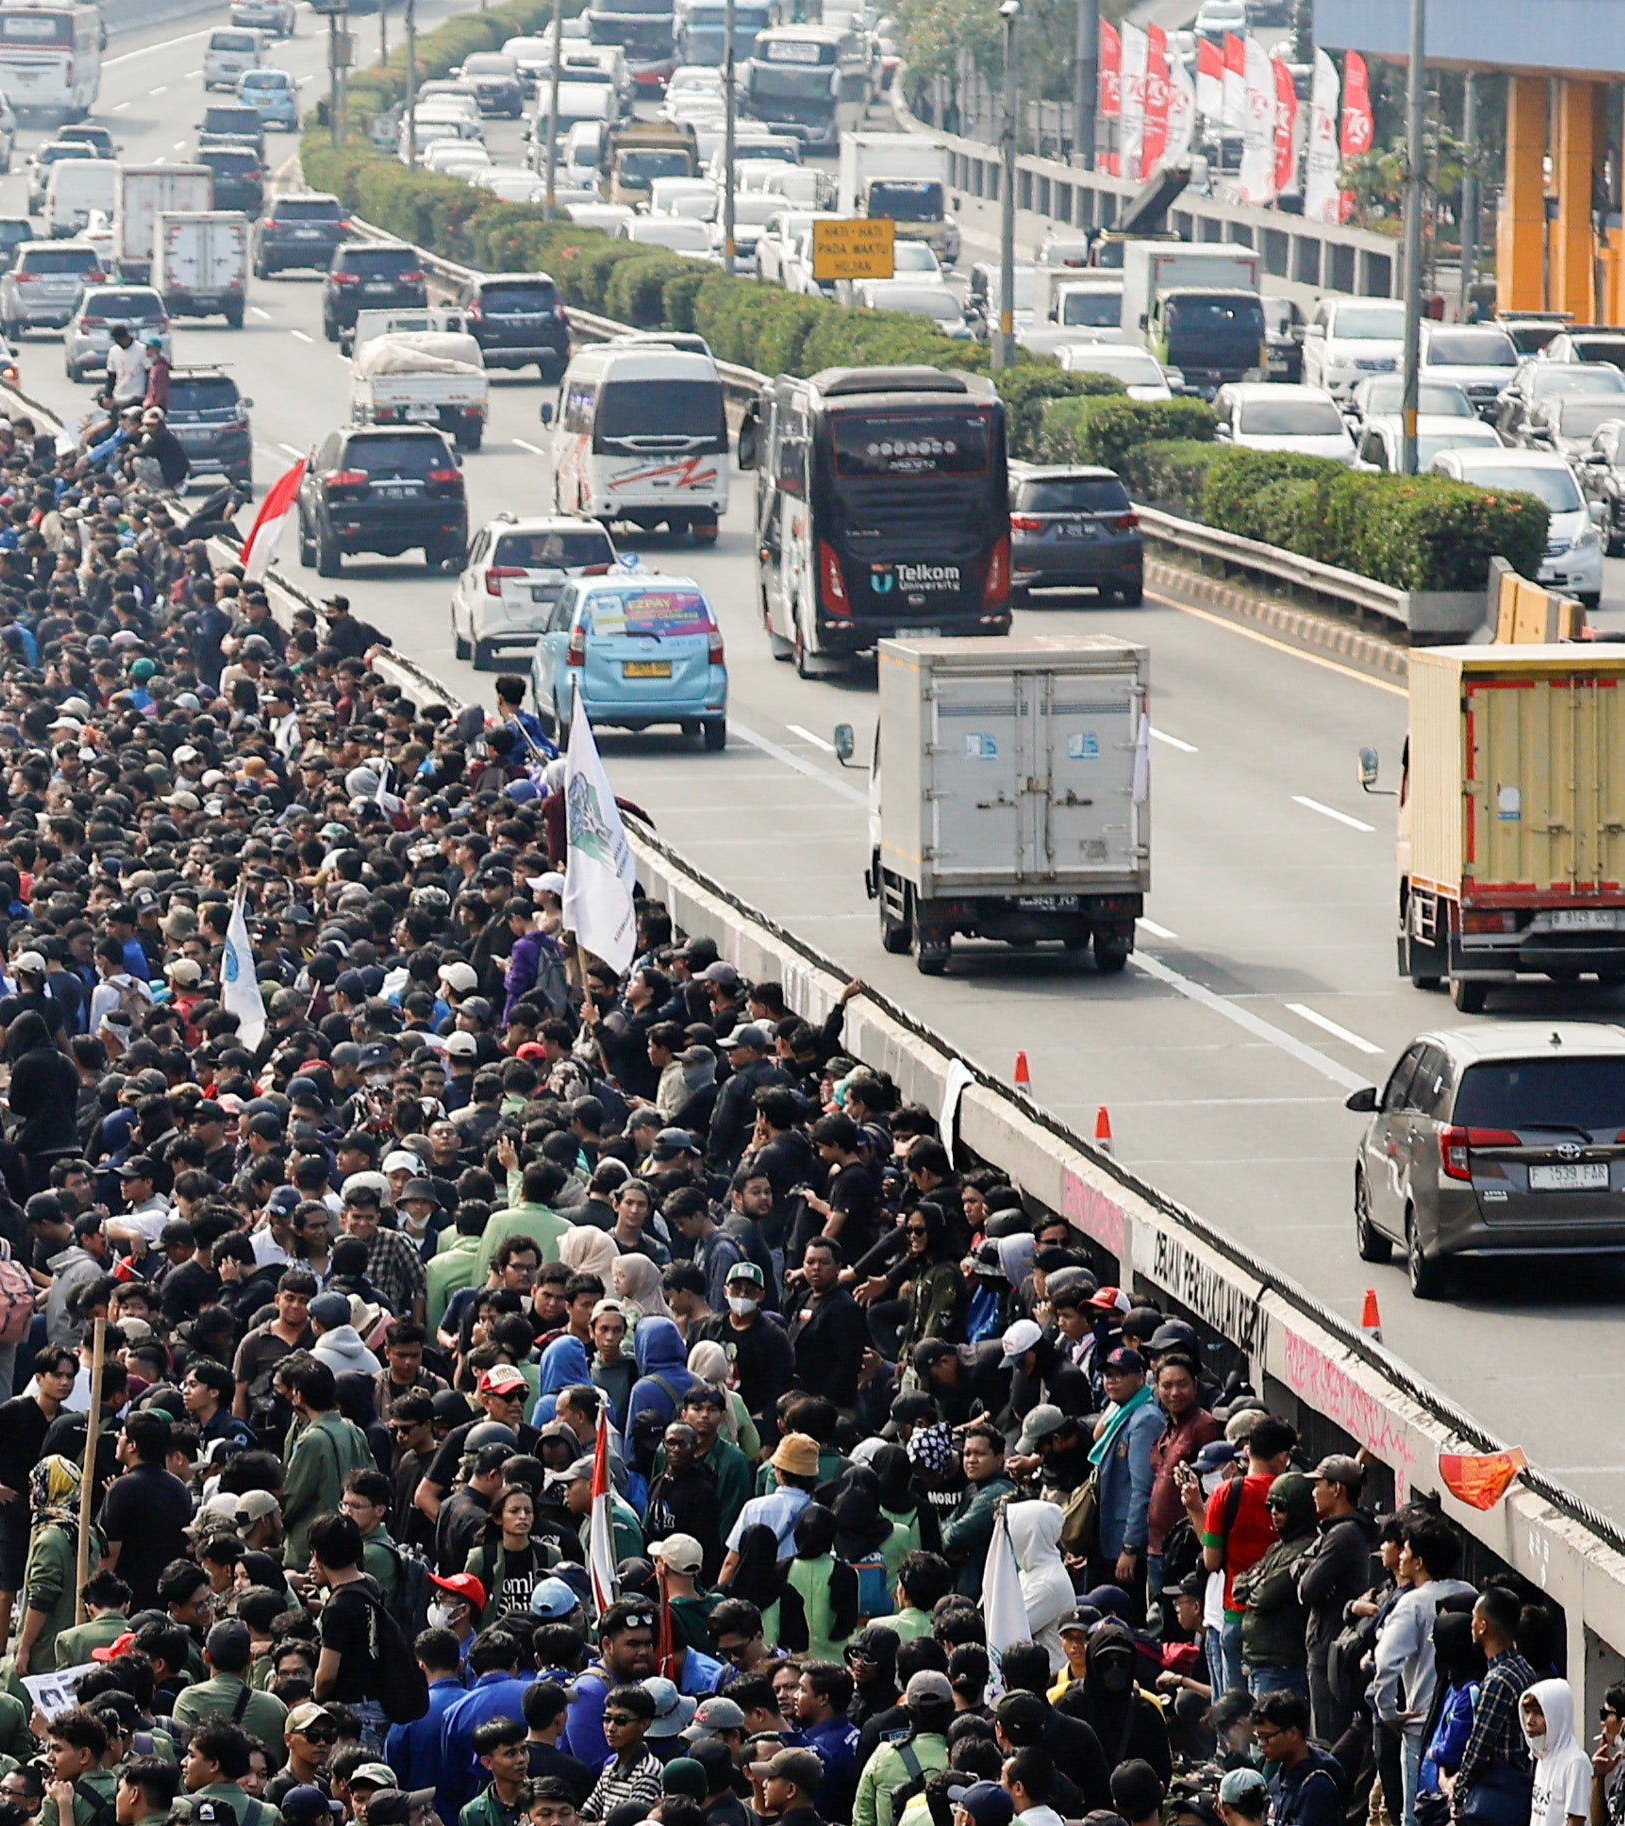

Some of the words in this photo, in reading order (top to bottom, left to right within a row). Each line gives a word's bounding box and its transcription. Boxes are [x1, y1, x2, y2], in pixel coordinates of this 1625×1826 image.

[896, 563, 960, 582] Telkom
[898, 581, 961, 594] University
[1531, 1167, 1537, 1180] F
